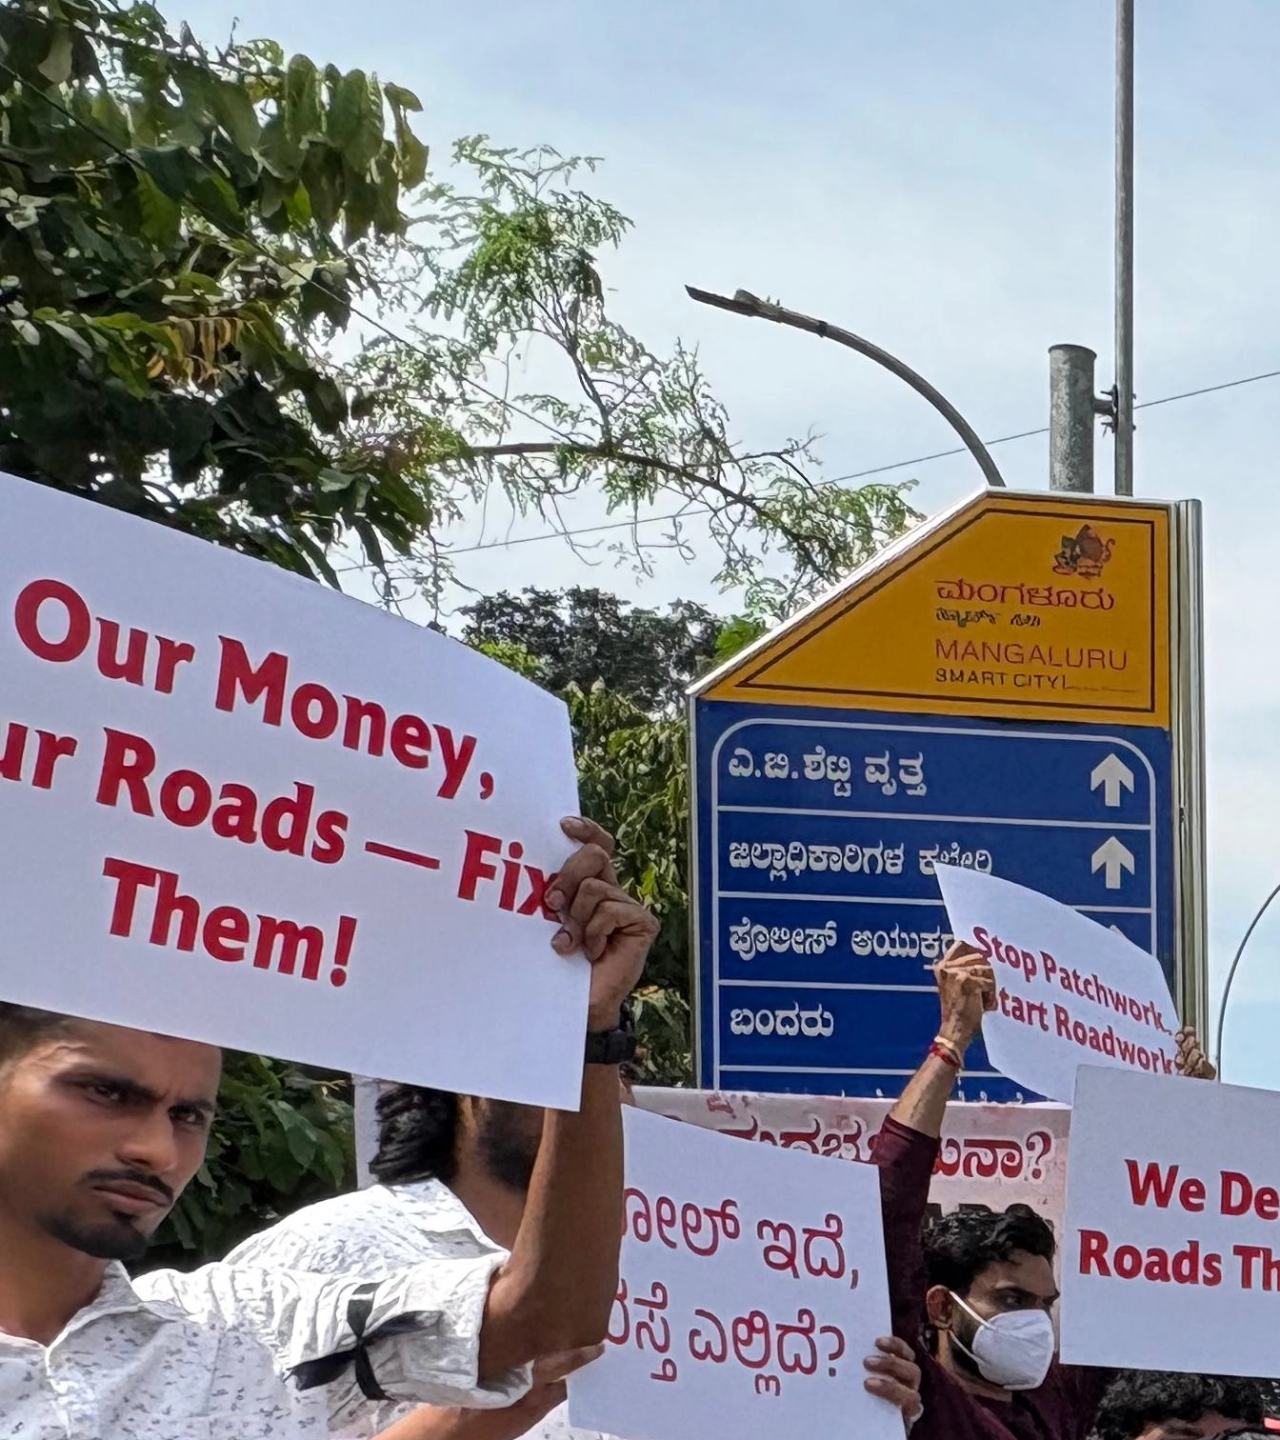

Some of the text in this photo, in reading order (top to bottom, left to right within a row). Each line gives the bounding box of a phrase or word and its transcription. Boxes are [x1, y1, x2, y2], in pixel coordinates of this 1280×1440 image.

[935, 578, 1115, 610] ಮಂಗಳೂರು
[935, 638, 1127, 670] MANGALURU
[935, 667, 1008, 686] SMART
[15, 579, 493, 800] Our Money,
[0, 723, 77, 789] ur
[96, 727, 348, 864] Roads
[864, 750, 928, 797] ವೃತ್ತ
[102, 857, 357, 987] Them!
[973, 926, 1038, 983] Stop
[730, 1000, 834, 1040] ಬಂದರು
[999, 987, 1049, 1031] tart
[1124, 1159, 1206, 1212] We
[757, 1213, 858, 1289] ಇದೆ,
[1077, 1229, 1221, 1286] Roads
[689, 1308, 845, 1396] ಎಲ್ಲಿದೆ?
